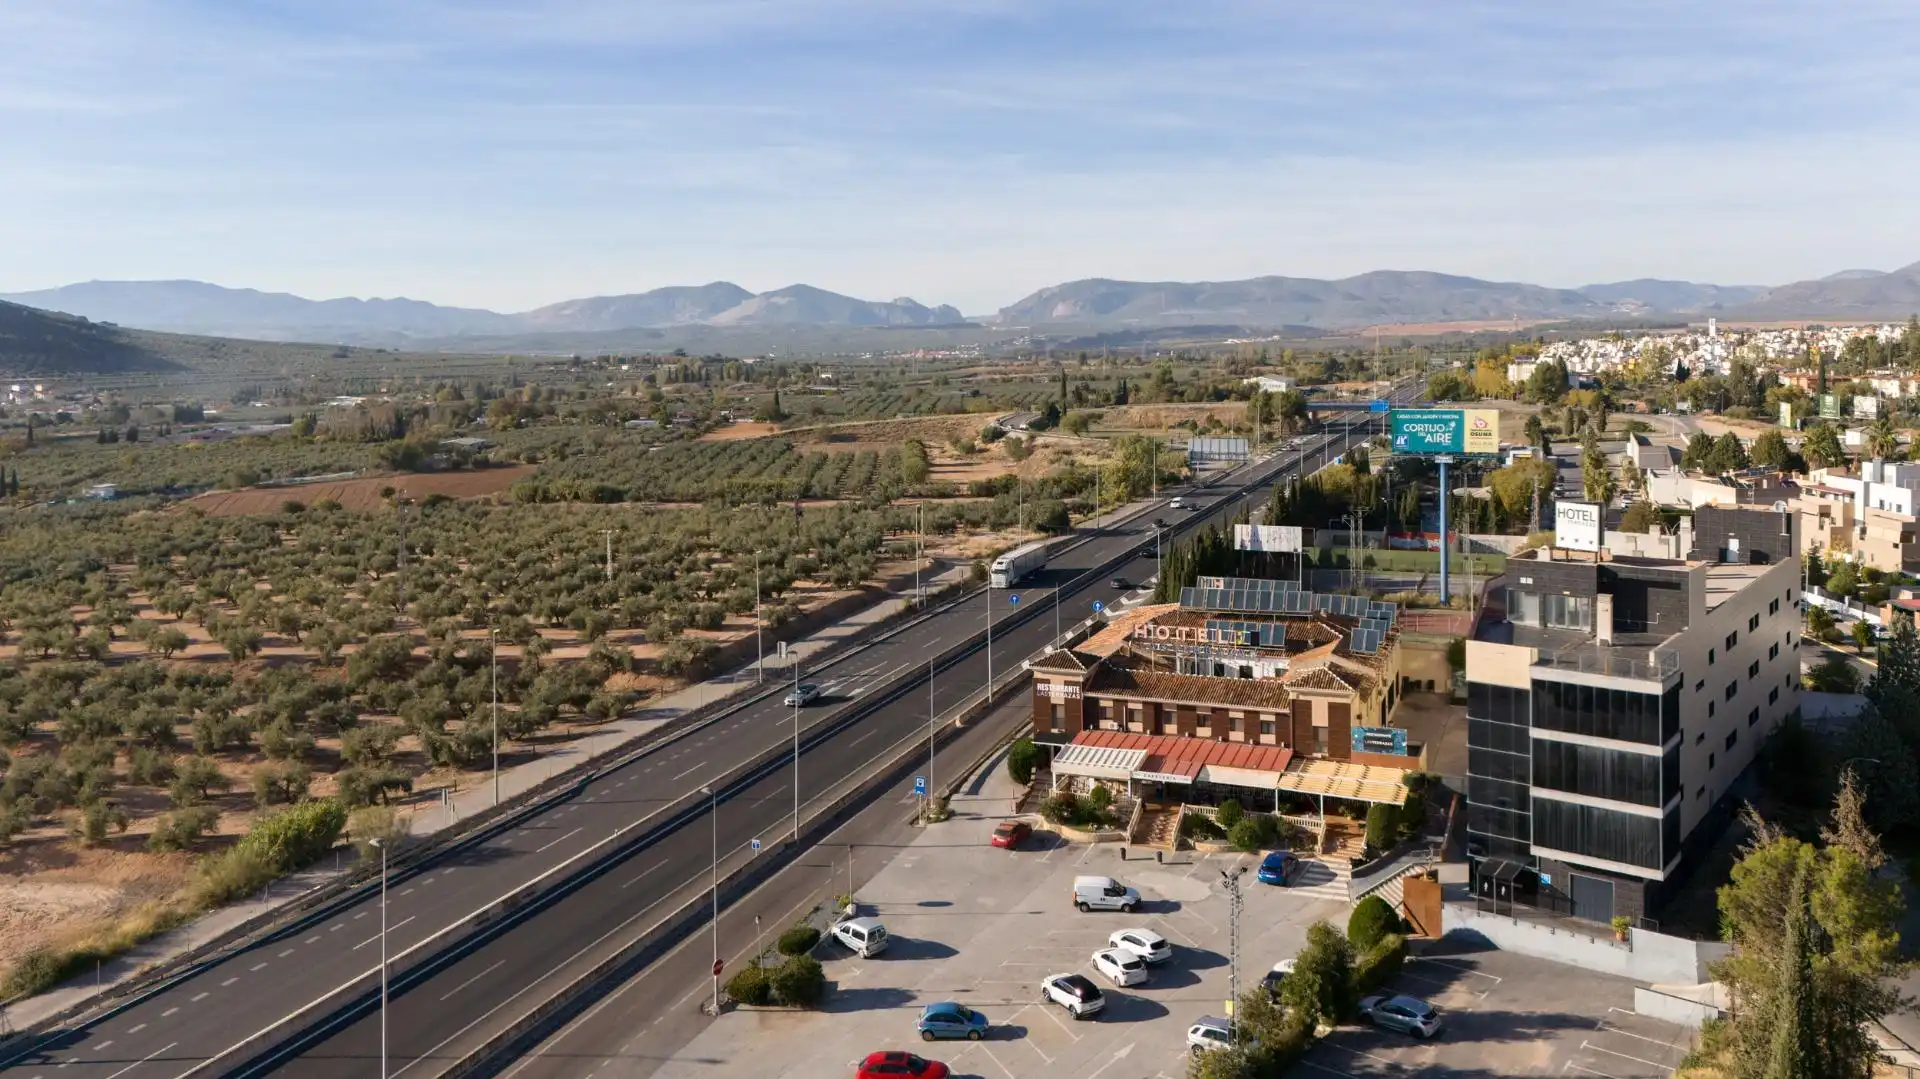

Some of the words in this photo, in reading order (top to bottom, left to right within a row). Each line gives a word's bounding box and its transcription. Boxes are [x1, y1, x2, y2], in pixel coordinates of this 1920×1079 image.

[1403, 423, 1445, 432] CORTIJO
[1424, 433, 1452, 443] AIRE
[1557, 507, 1596, 522] HOTEL
[1133, 623, 1230, 645] HOTEL
